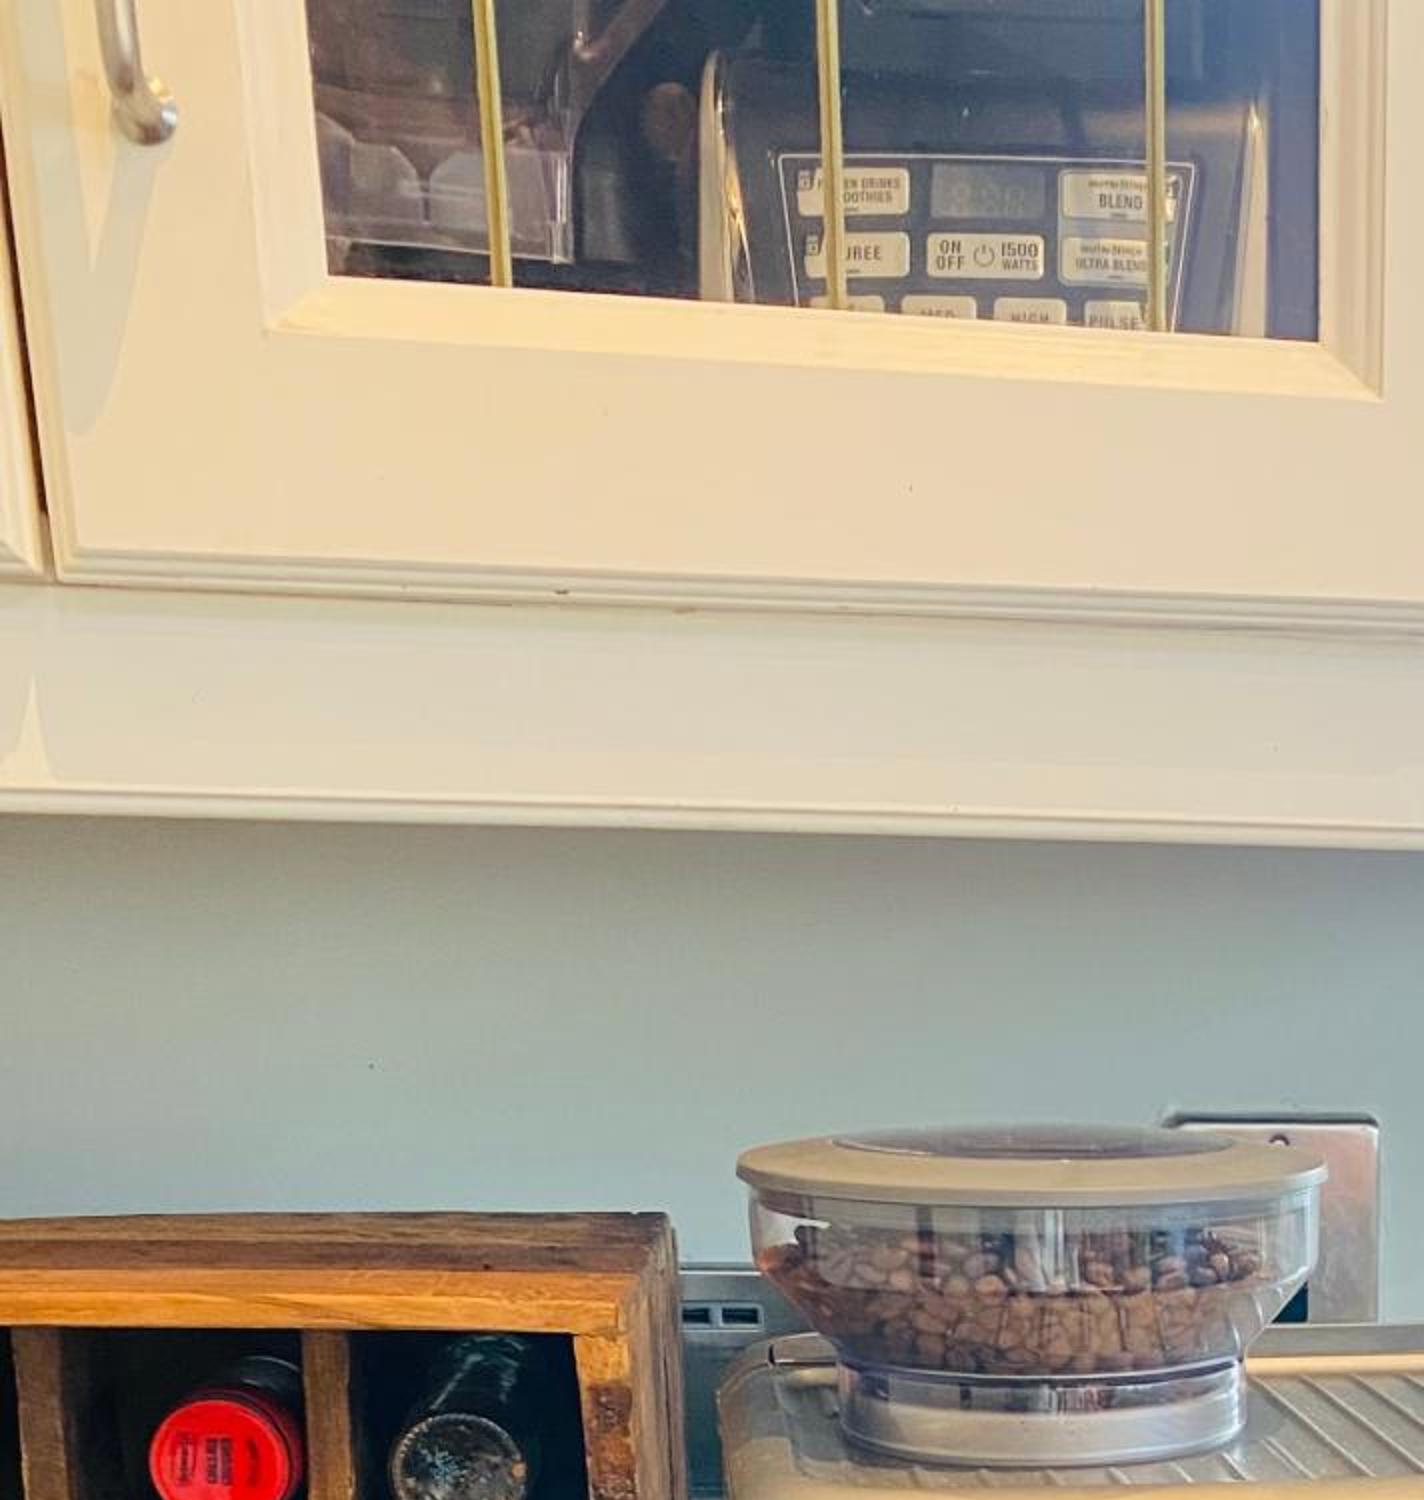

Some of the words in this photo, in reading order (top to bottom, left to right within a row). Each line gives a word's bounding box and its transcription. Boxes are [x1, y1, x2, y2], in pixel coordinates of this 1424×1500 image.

[1099, 194, 1143, 210] BLEND
[939, 240, 961, 254] ON
[1001, 242, 1039, 258] 1500
[936, 255, 964, 271] OFF
[1002, 259, 1040, 272] WATTS
